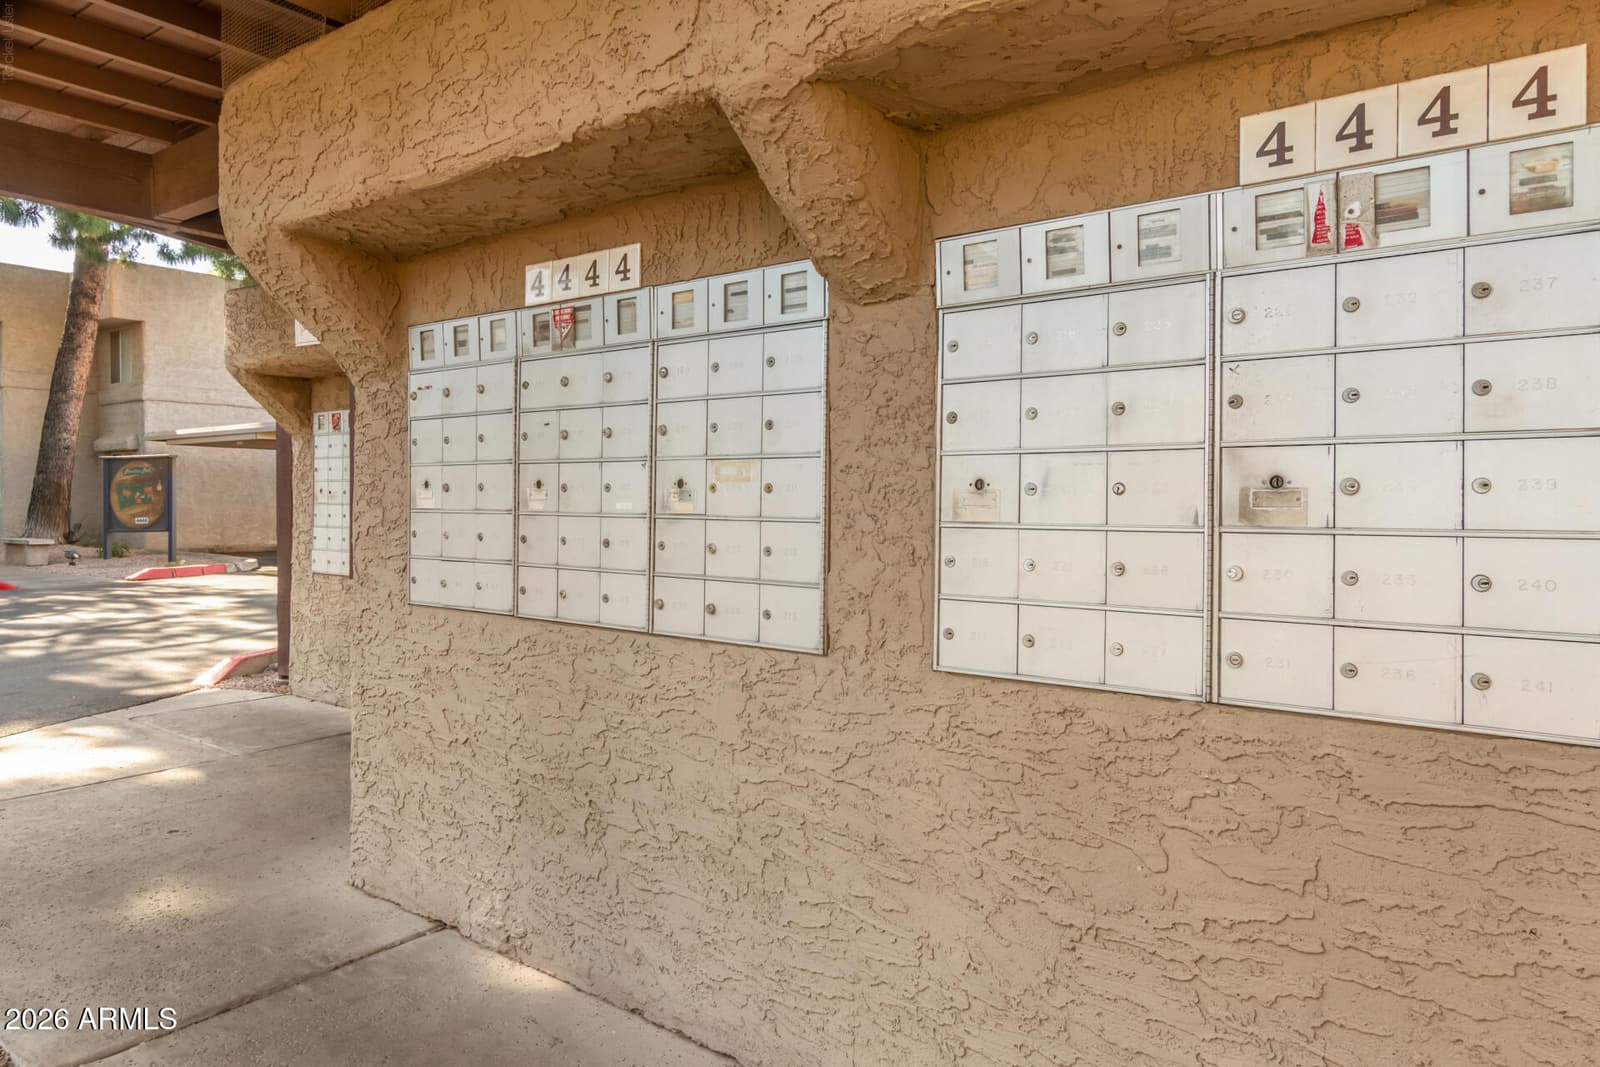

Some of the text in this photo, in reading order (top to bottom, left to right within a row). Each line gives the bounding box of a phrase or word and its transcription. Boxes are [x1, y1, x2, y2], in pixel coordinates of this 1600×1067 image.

[1519, 276, 1558, 293] 237
[1517, 377, 1557, 392] 238
[1517, 578, 1557, 593] 240
[1520, 679, 1554, 694] 241
